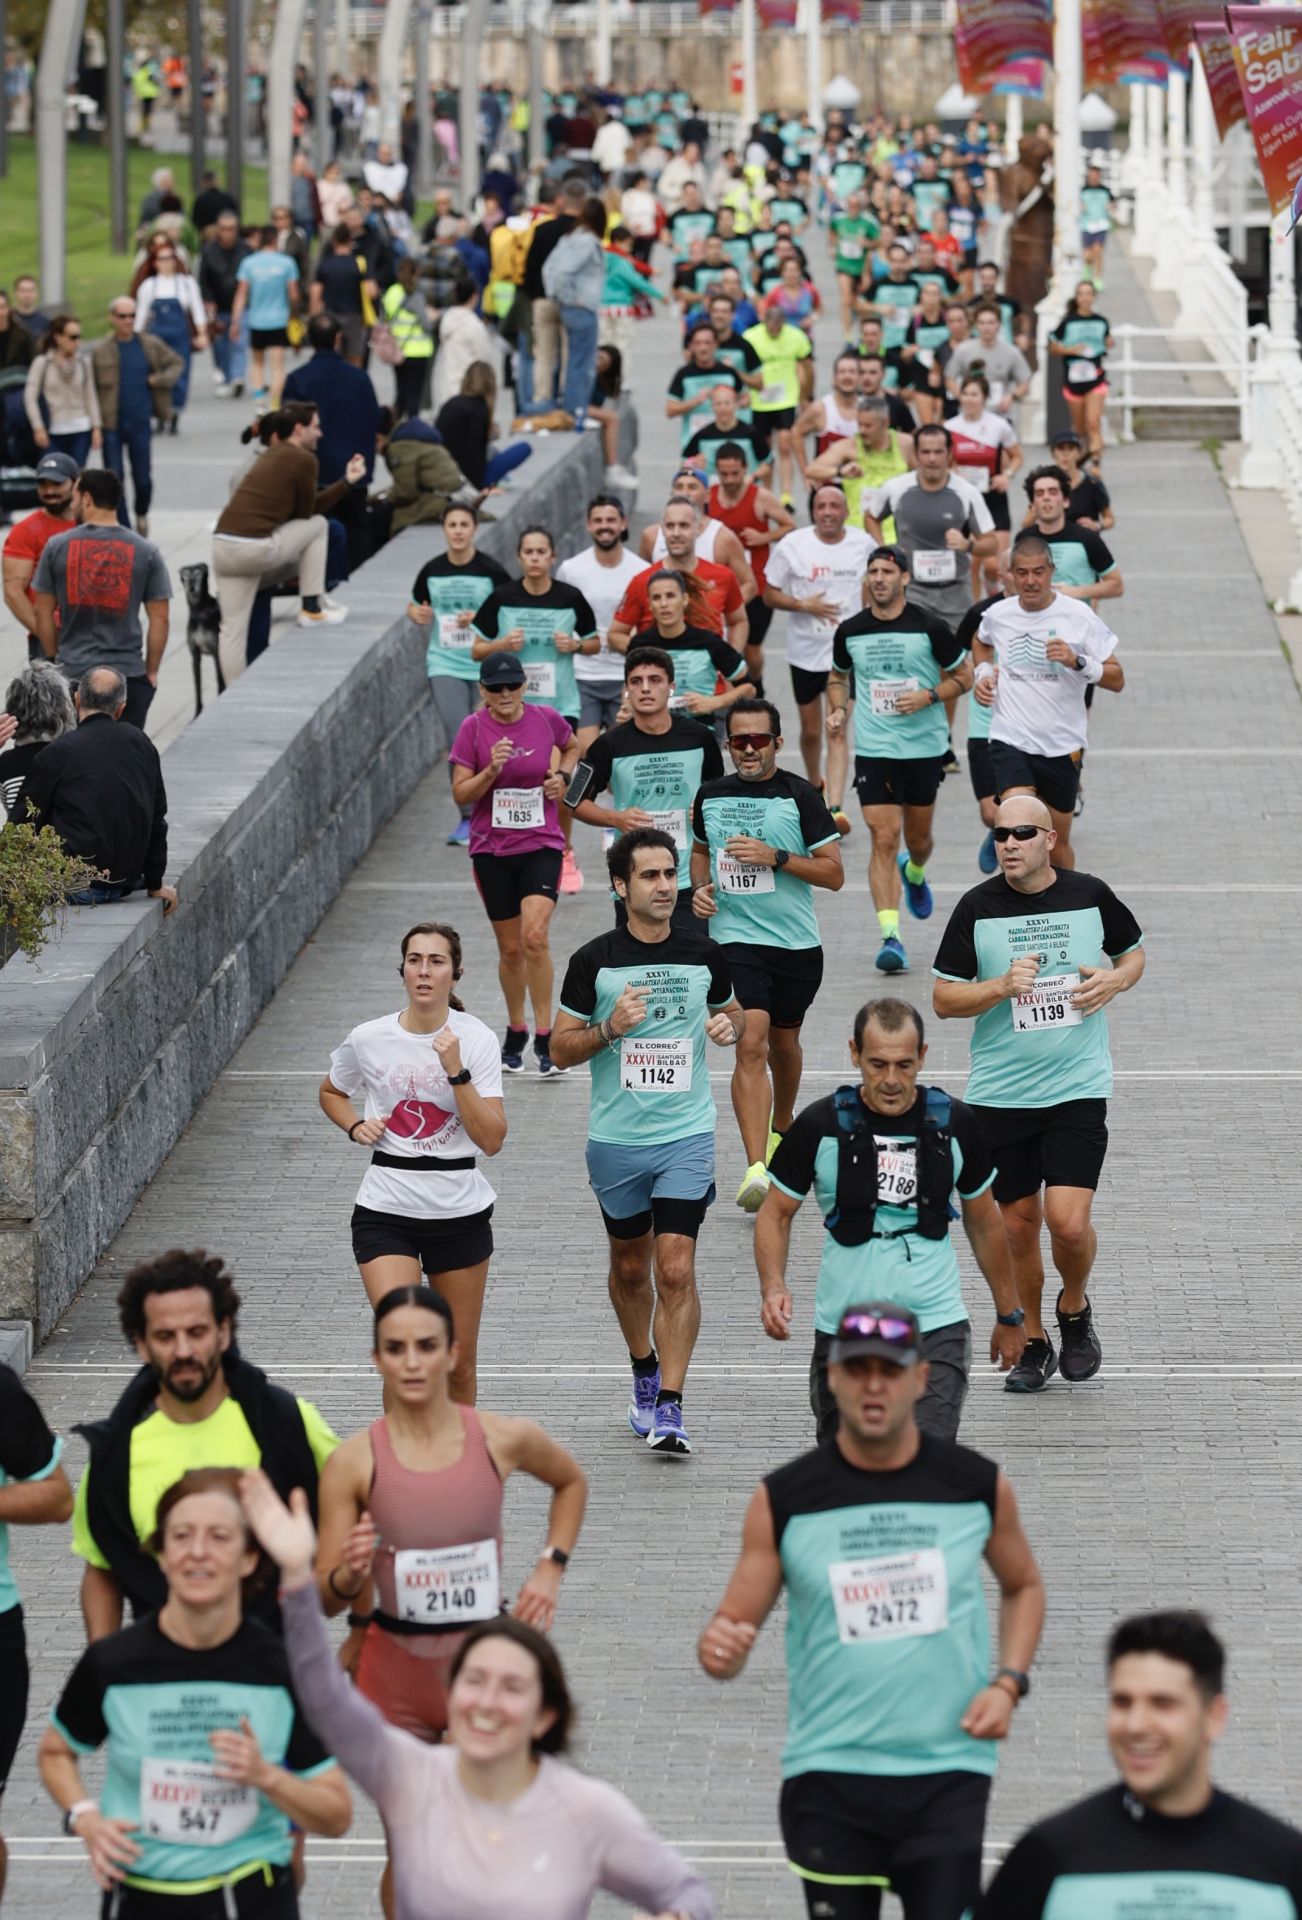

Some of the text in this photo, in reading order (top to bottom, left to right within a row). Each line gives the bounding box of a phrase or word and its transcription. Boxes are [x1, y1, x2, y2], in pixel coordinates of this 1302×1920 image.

[1238, 25, 1298, 65] Fair
[508, 810, 532, 822] 1635
[720, 863, 740, 873] XXXVI
[729, 875, 757, 888] 1167
[1026, 918, 1050, 926] XXXVI
[646, 970, 670, 978] XXXVI
[1033, 980, 1064, 988] CORREO
[1017, 992, 1044, 1006] XXXVI
[1046, 989, 1072, 997] SANTURC
[1031, 1004, 1065, 1022] 1139
[1019, 1019, 1027, 1030] k
[626, 1054, 655, 1066] XXXVI
[640, 1068, 675, 1084] 1142
[625, 1078, 633, 1089] k
[878, 1171, 916, 1196] 2188
[426, 1587, 476, 1612] 2140
[867, 1598, 920, 1628] 2472
[179, 1807, 221, 1831] 547
